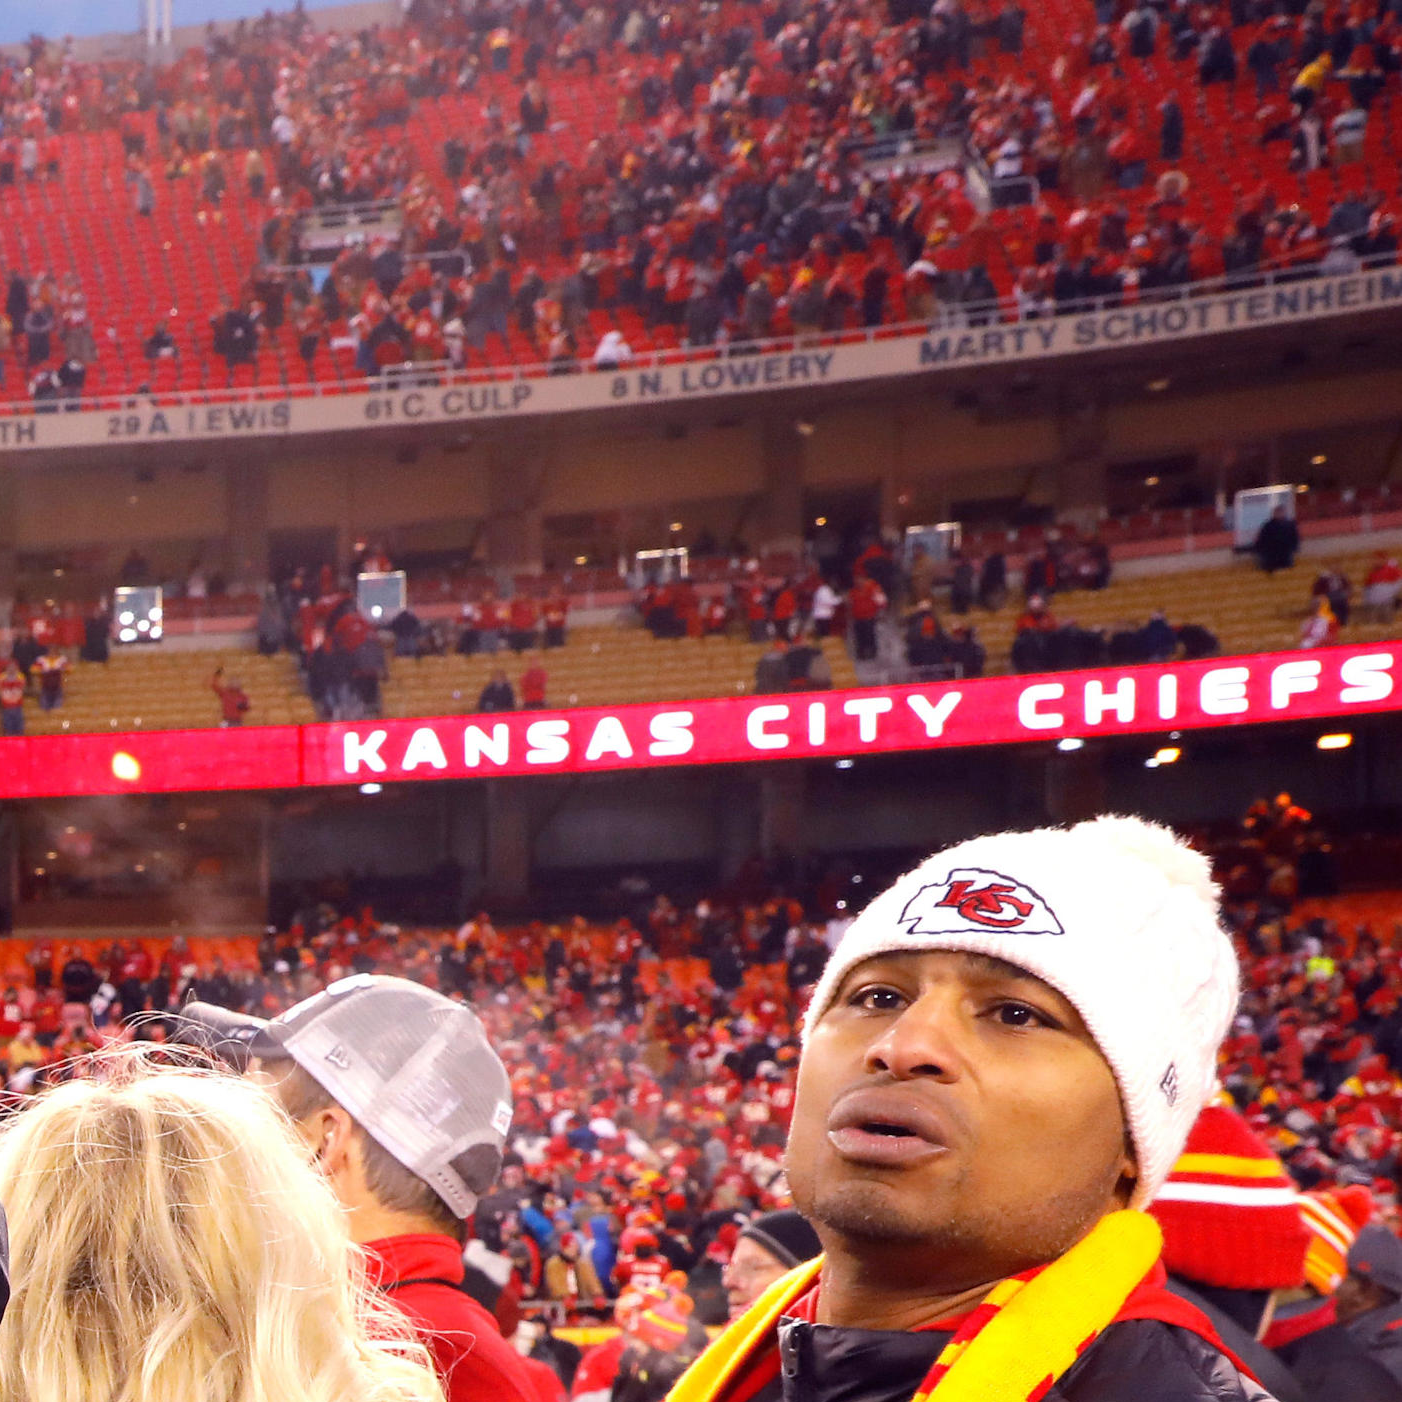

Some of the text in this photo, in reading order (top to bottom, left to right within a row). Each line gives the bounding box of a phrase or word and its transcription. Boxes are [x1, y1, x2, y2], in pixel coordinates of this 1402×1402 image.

[920, 323, 1057, 364] MARTY
[611, 376, 628, 398] 8
[680, 352, 835, 392] LOWERY
[364, 398, 394, 420] 61
[441, 384, 532, 414] CULP
[107, 415, 141, 436] 29
[343, 652, 1394, 774] KANSAS CITY CHIEFS
[934, 879, 1034, 929] KC
